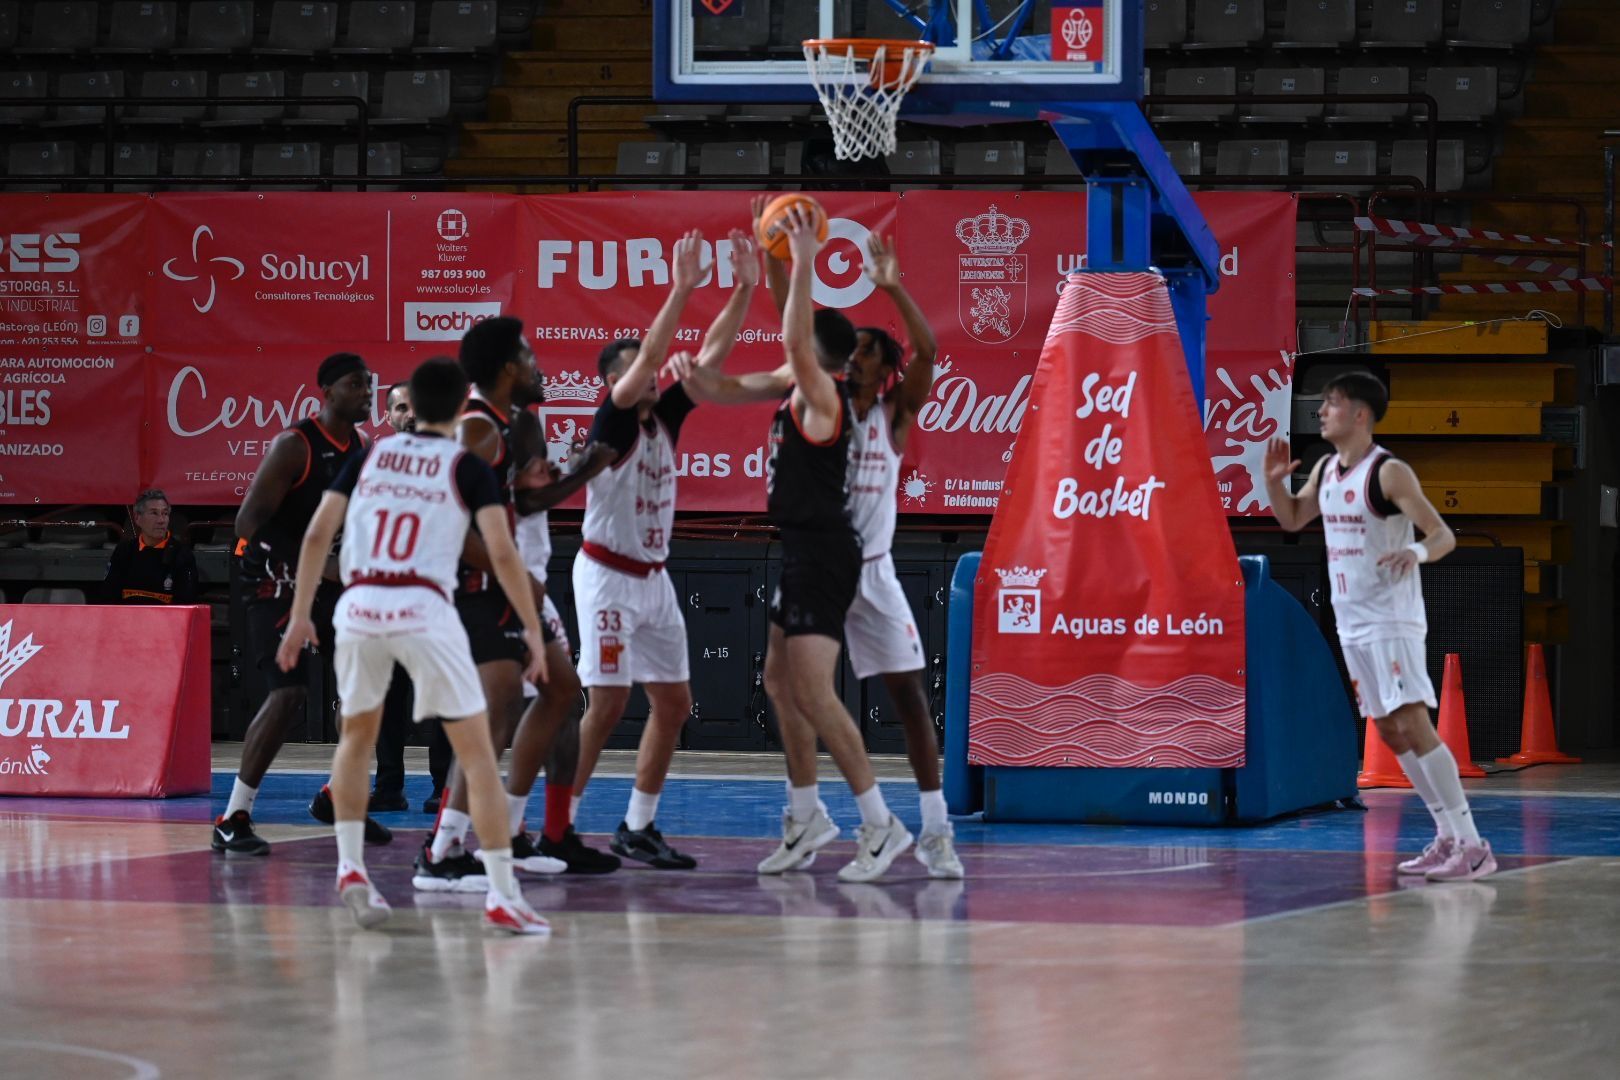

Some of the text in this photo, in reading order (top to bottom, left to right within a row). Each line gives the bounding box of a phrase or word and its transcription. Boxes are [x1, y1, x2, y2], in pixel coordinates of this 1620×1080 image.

[0, 233, 80, 273] ES
[436, 243, 468, 252] Wolters
[438, 253, 466, 262] Kluwer
[260, 253, 369, 288] Solucyl
[421, 269, 486, 279] 987 093 900
[57, 280, 80, 293] S.L.
[416, 284, 491, 296] www.solucyl.es
[254, 291, 375, 303] Consultores Tecnológicos
[7, 299, 79, 312] INDUSTRIAL
[535, 327, 609, 340] RESERVAS:
[613, 328, 640, 340] 622
[675, 328, 700, 341] 427
[28, 356, 115, 369] AUTOMOCIÓN
[4, 371, 66, 384] AGRÍCOLA
[1076, 371, 1137, 418] Sed
[1084, 423, 1122, 470] de
[377, 448, 440, 478] BULTÓ
[958, 479, 970, 490] La
[1052, 475, 1165, 520] Basket
[371, 508, 421, 561] 10
[642, 528, 664, 549] 33
[597, 610, 622, 631] 33
[1051, 613, 1223, 639] Aguas de León
[703, 647, 729, 659] A-15
[1148, 792, 1208, 805] MONDO
